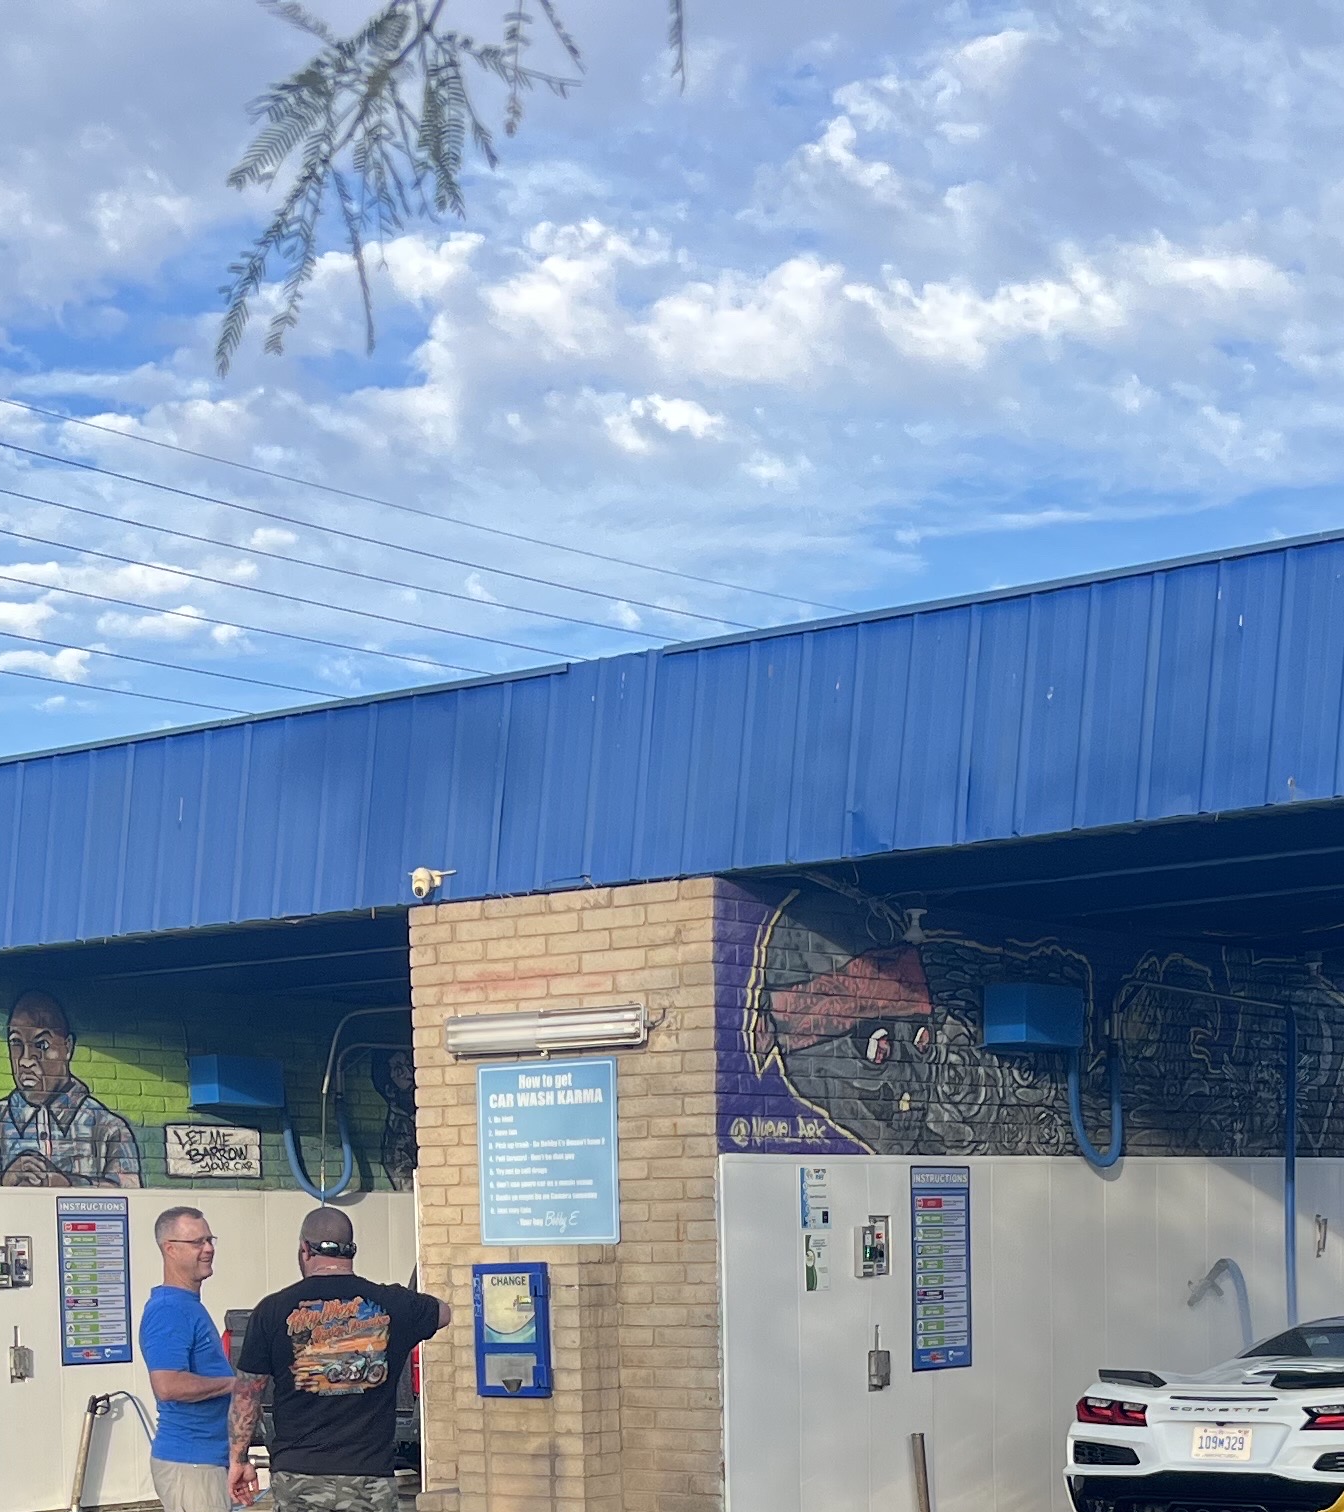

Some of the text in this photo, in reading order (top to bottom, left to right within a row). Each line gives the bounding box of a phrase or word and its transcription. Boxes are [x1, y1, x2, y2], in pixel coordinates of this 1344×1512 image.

[518, 1072, 572, 1089] How to get
[489, 1088, 603, 1108] CAR WASH KARMA
[173, 1129, 234, 1150] LET ME
[913, 1173, 968, 1184] INSTRUCTIONS
[60, 1202, 125, 1211] INSTRUCTIONS
[491, 1276, 526, 1287] CHANGE
[1198, 1435, 1245, 1451] 109M329
